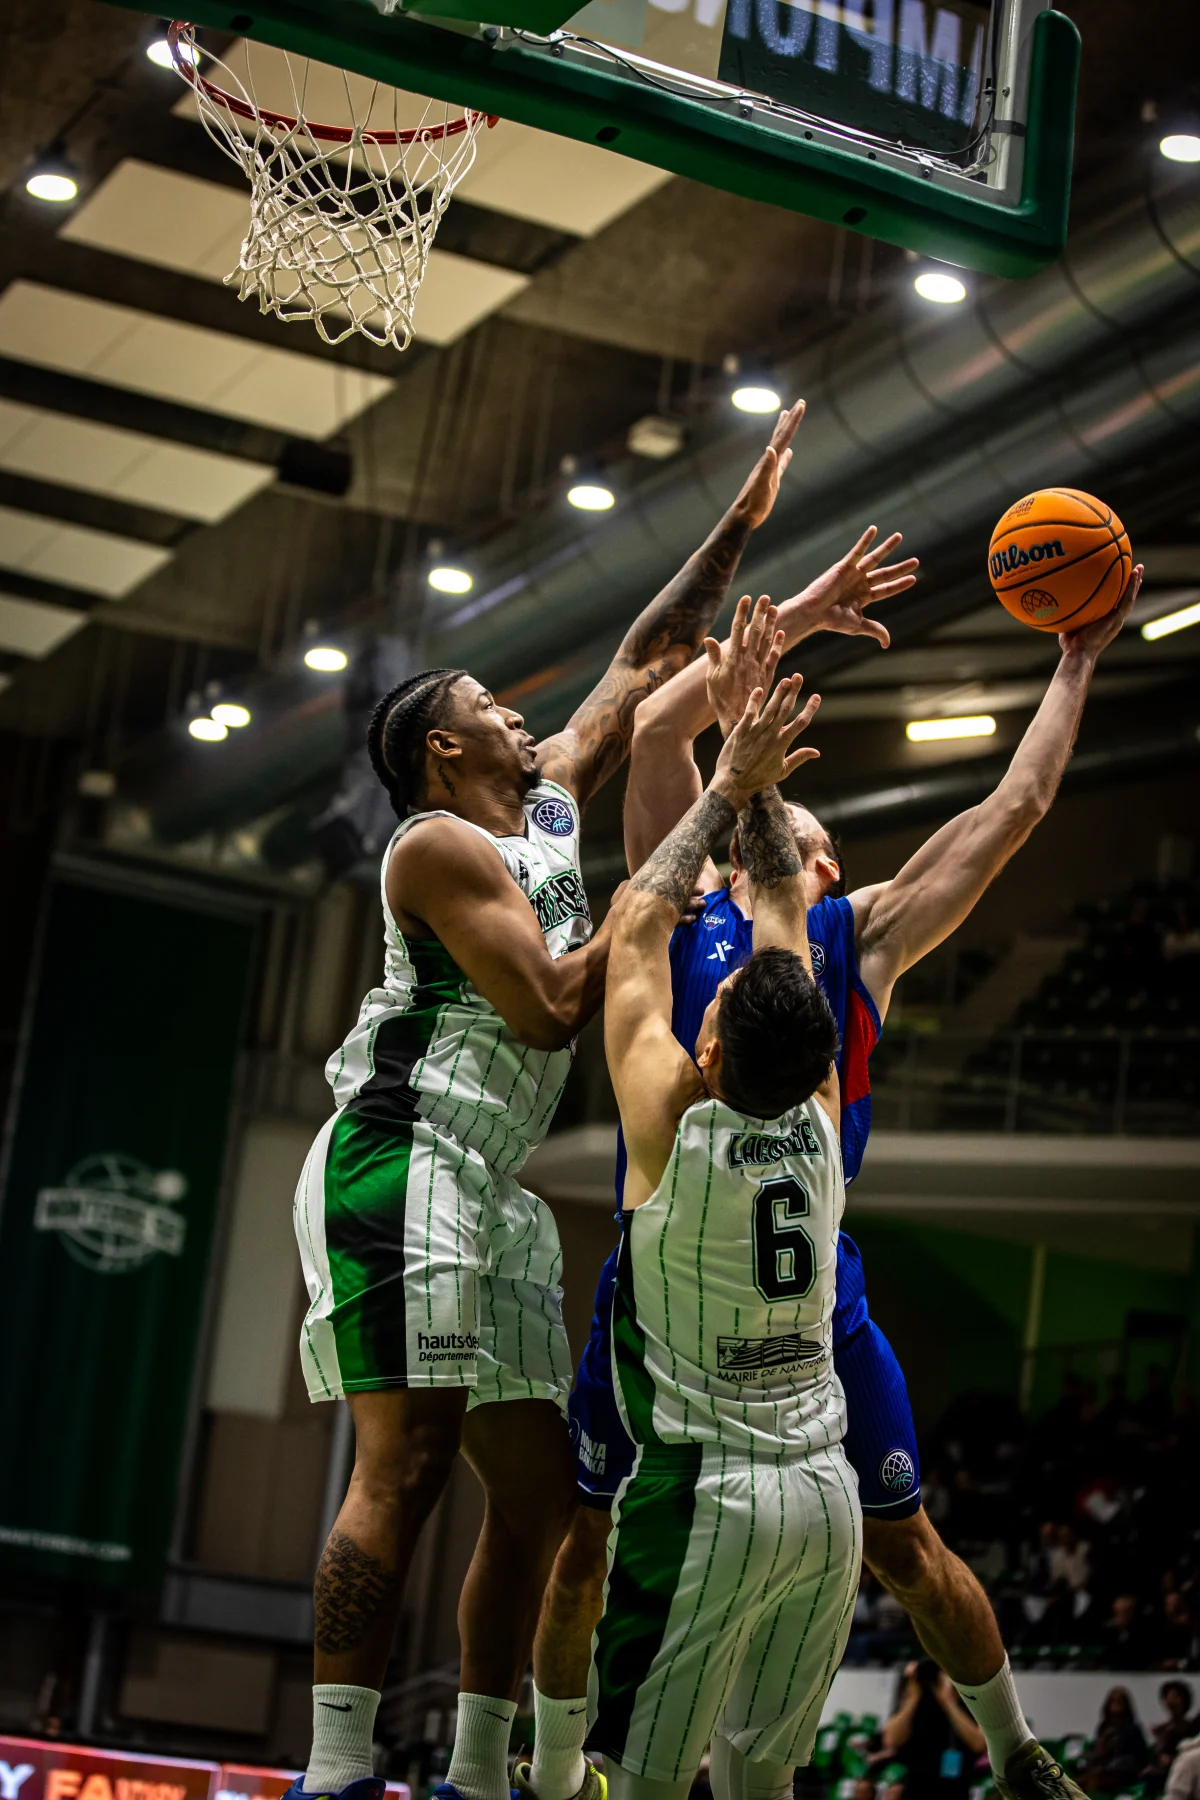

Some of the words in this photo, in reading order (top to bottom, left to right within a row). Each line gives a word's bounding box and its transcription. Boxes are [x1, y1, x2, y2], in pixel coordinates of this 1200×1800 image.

[989, 540, 1067, 581] Wilson
[752, 1174, 817, 1304] 6
[717, 1369, 759, 1382] MAIRIE
[761, 1367, 778, 1378] DE
